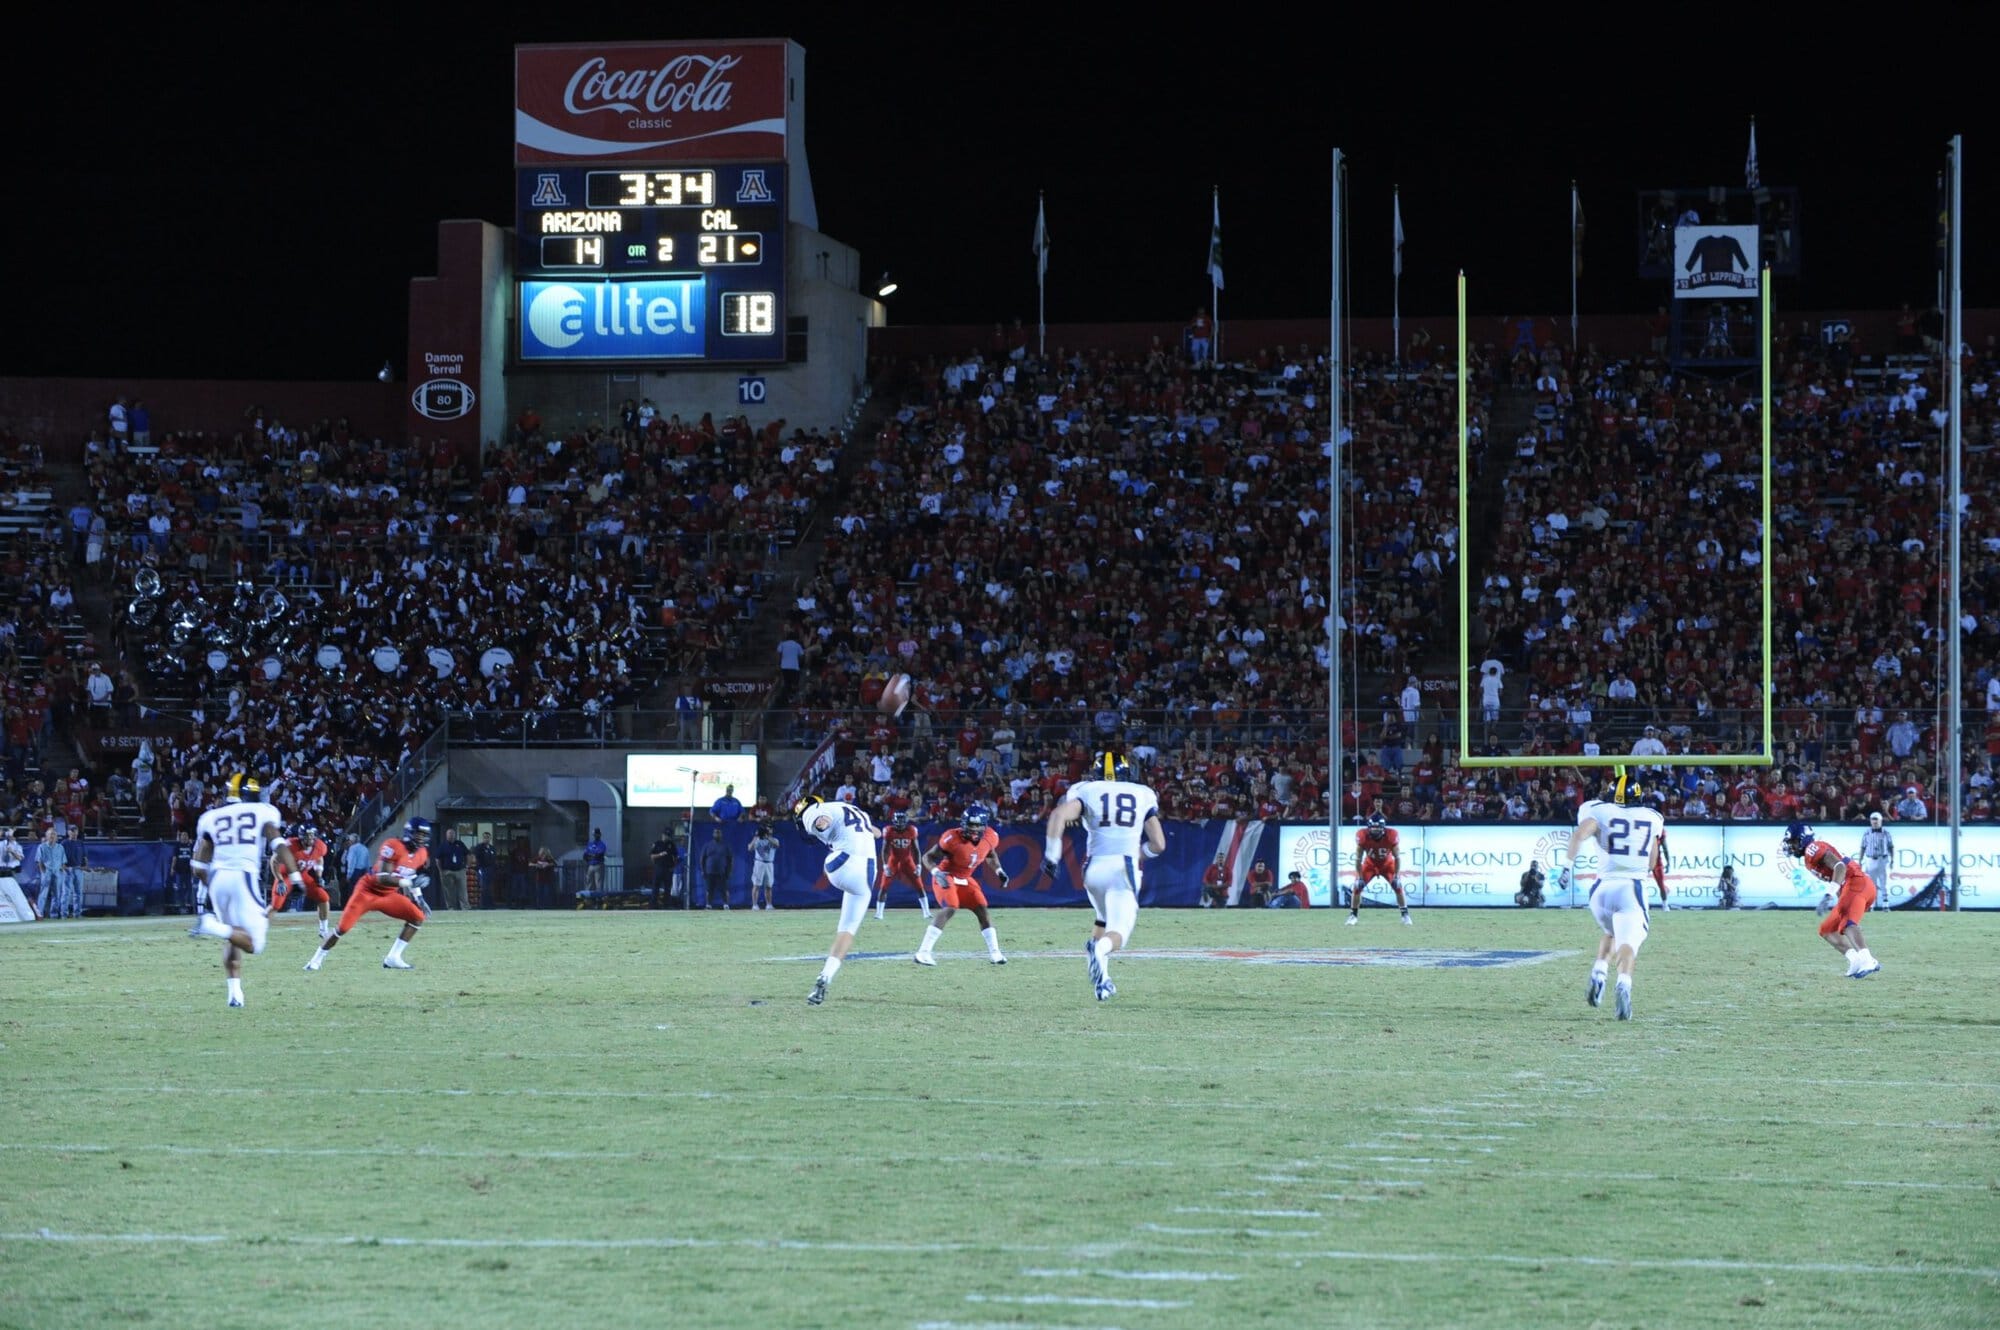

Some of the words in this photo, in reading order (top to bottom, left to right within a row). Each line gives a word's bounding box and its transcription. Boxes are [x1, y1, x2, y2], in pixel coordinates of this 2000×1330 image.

[563, 54, 743, 115] Coca-Cola
[627, 117, 673, 129] classic
[618, 172, 713, 206] 3:34
[541, 211, 623, 233] ARIZONA
[701, 209, 739, 231] CAL
[575, 237, 601, 265] 14
[627, 244, 647, 257] QTR
[657, 237, 674, 262] 2
[700, 235, 736, 263] 21
[530, 283, 697, 338] alltel
[738, 294, 773, 333] 18
[425, 352, 464, 363] Damon
[427, 364, 462, 375] Terrell
[437, 395, 452, 405] 80
[740, 380, 764, 401] 10
[1099, 792, 1136, 828] 18
[214, 812, 256, 846] 22
[1608, 818, 1652, 857] 27
[1436, 882, 1492, 895] HOTEL
